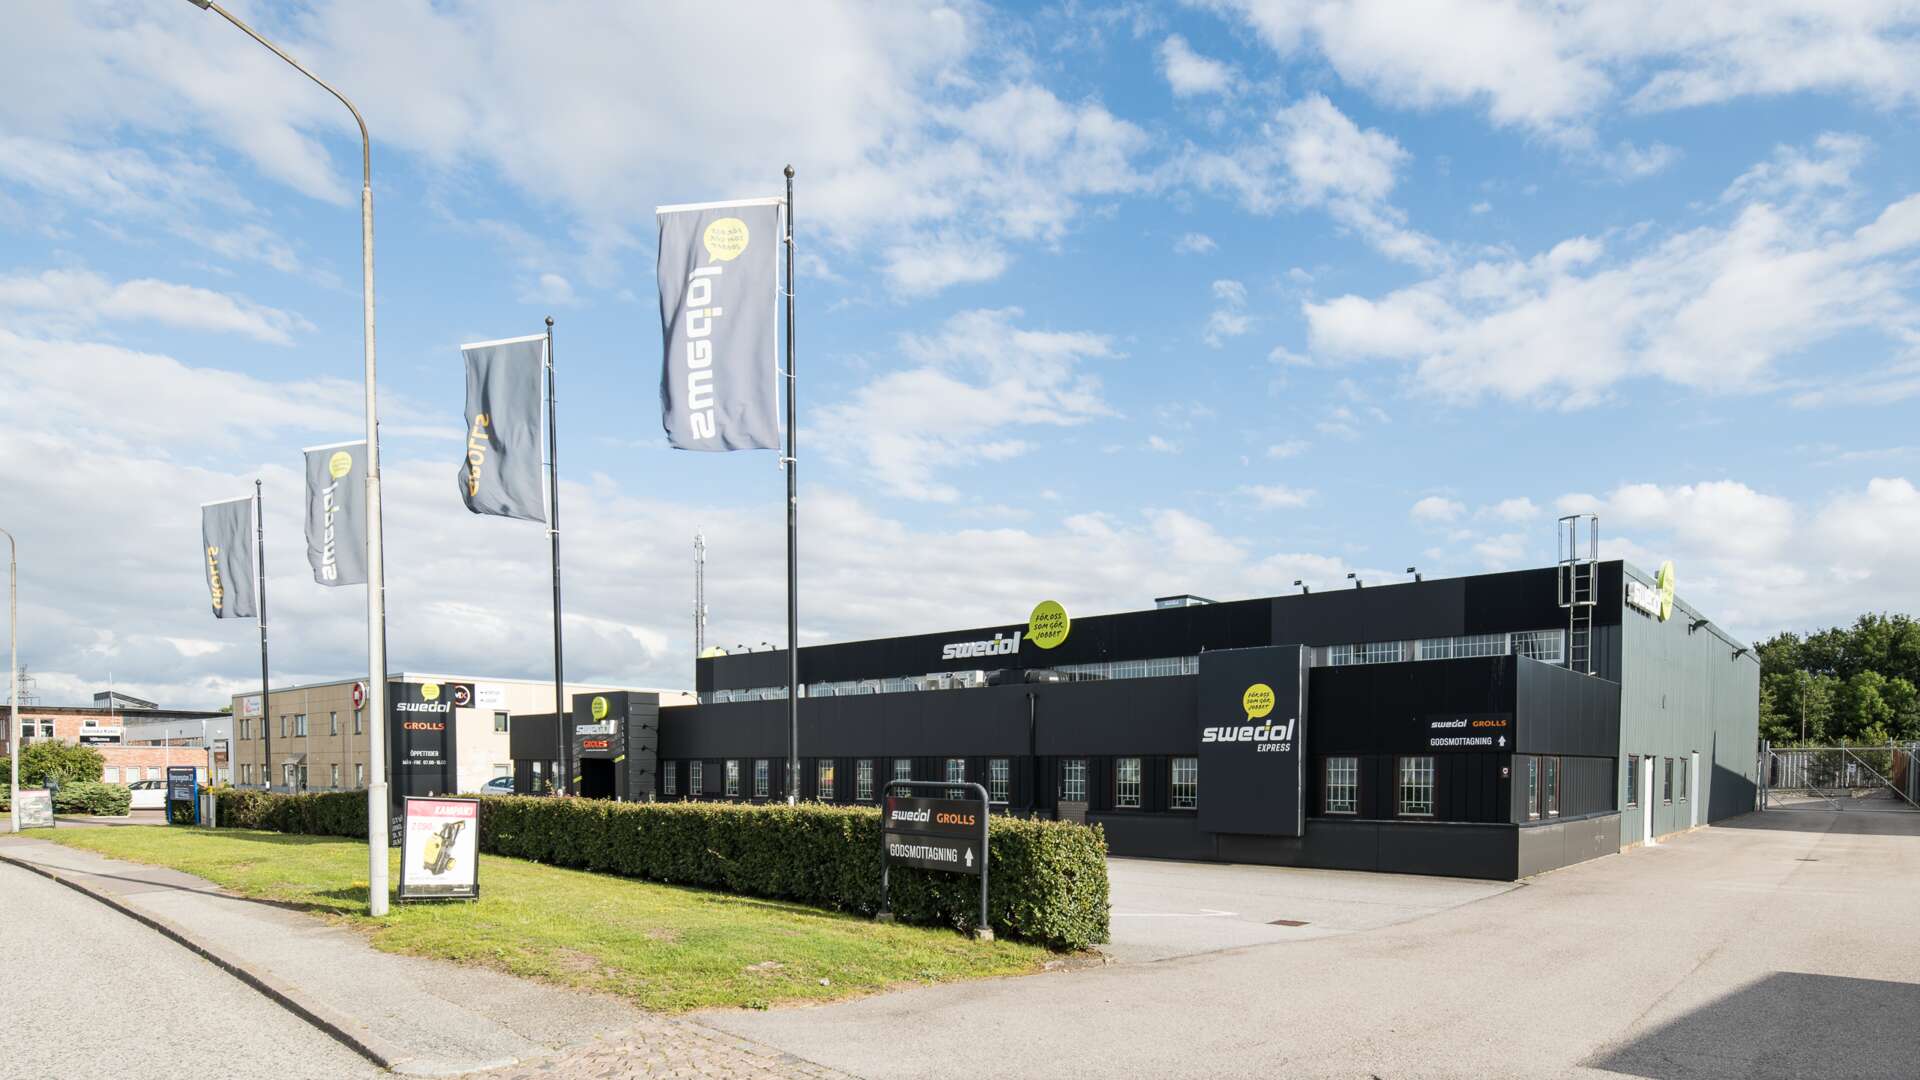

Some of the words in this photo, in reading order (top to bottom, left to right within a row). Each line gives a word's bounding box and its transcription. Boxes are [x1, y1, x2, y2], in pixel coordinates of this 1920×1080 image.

[1050, 613, 1062, 621] OSS
[1034, 623, 1049, 631] SOM
[1036, 630, 1062, 640] JOBBET
[942, 631, 1021, 659] swedol
[396, 701, 451, 713] swedol
[404, 722, 446, 731] GROLLS
[1431, 719, 1468, 728] swedol
[1472, 719, 1507, 727] GROLLS
[1202, 718, 1295, 743] swedol
[1430, 736, 1492, 746] GODSMOTTAGNING
[1257, 743, 1291, 752] EXPRESS
[891, 807, 931, 822] swedol
[936, 813, 975, 826] GROLLS
[890, 843, 958, 862] GODSMOTTAGNING
